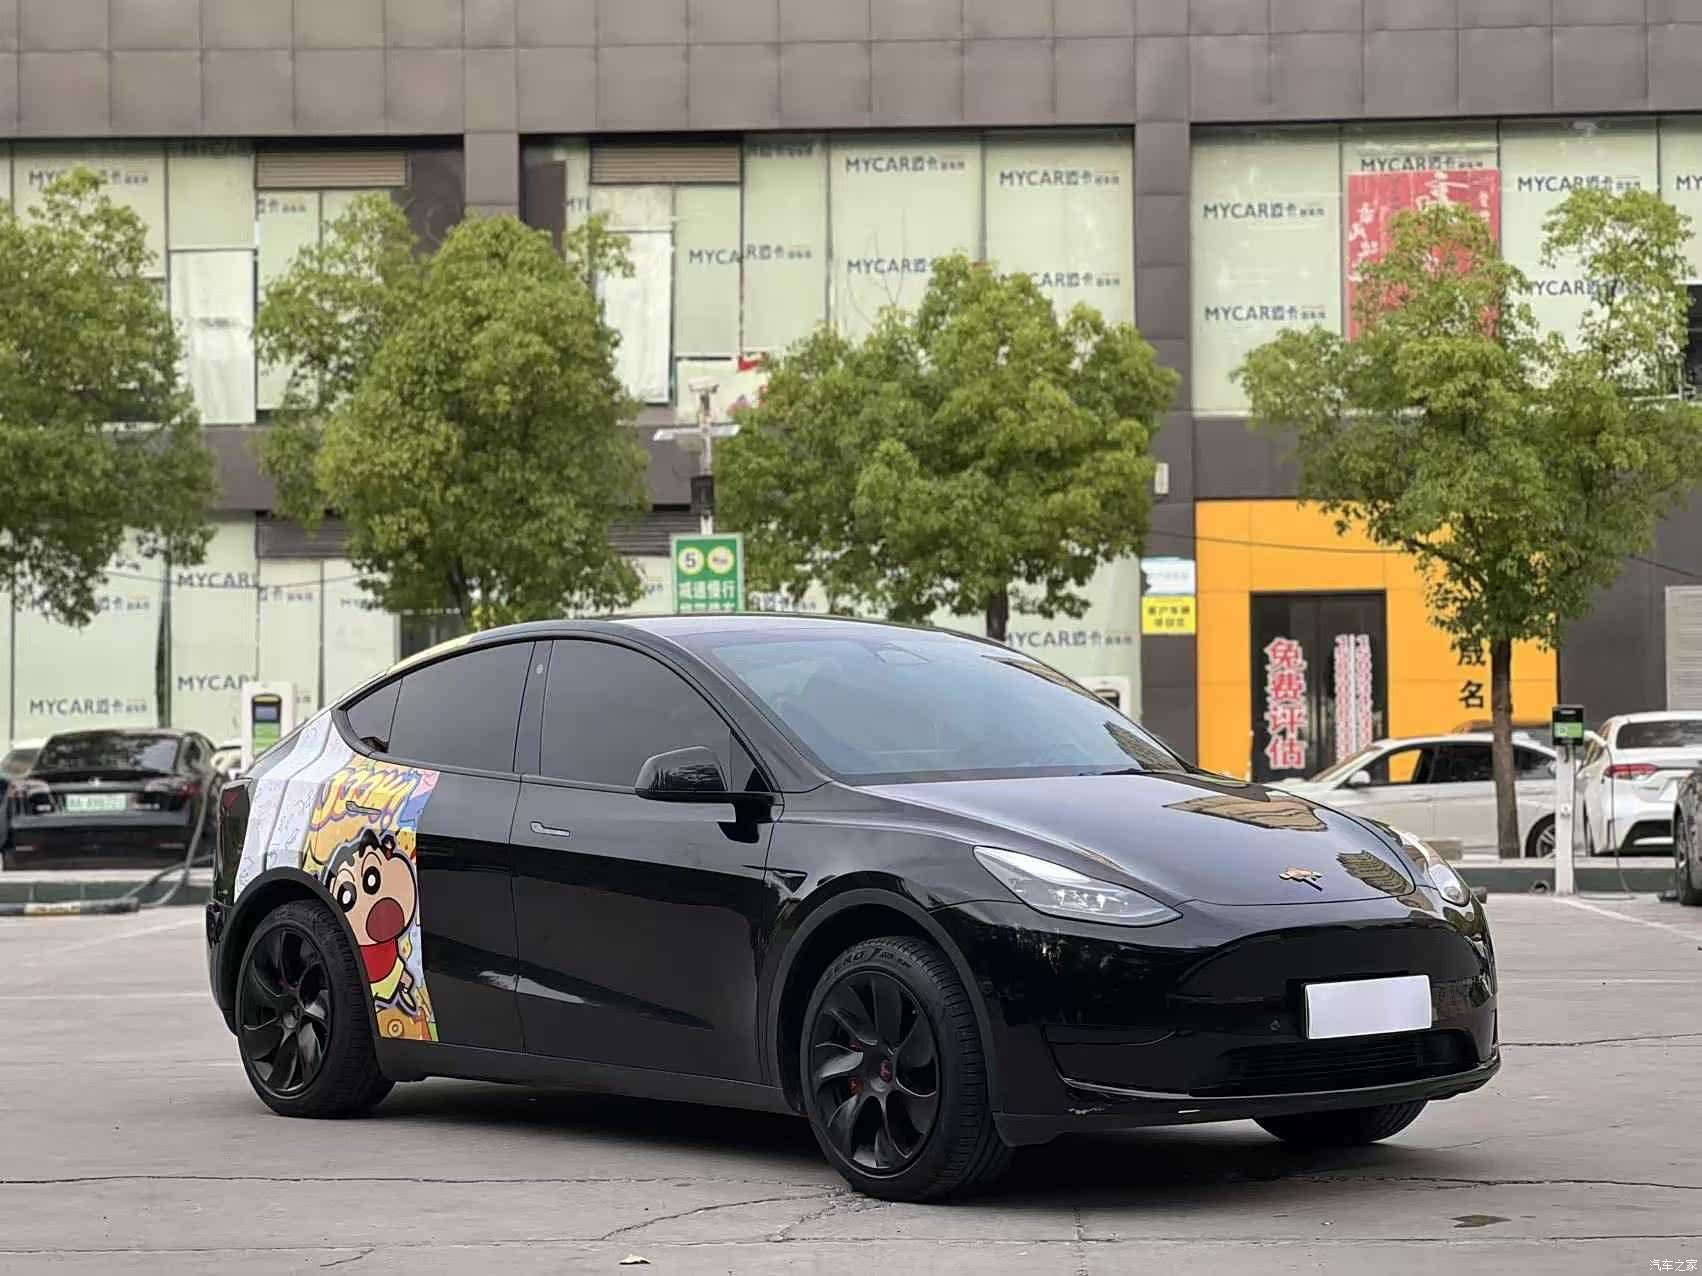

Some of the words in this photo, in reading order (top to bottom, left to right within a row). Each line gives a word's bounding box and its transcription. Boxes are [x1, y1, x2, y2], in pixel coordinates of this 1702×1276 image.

[846, 157, 909, 173] MYCAR
[1361, 156, 1426, 172] MYCAR
[1000, 170, 1064, 186] MYCAR
[1203, 203, 1271, 219] MYCAR
[847, 258, 914, 273] MYCAR
[1205, 305, 1272, 321] MYCAR
[684, 552, 697, 568] 5
[30, 699, 98, 716] MYCAR
[1264, 637, 1308, 769] 免费评估
